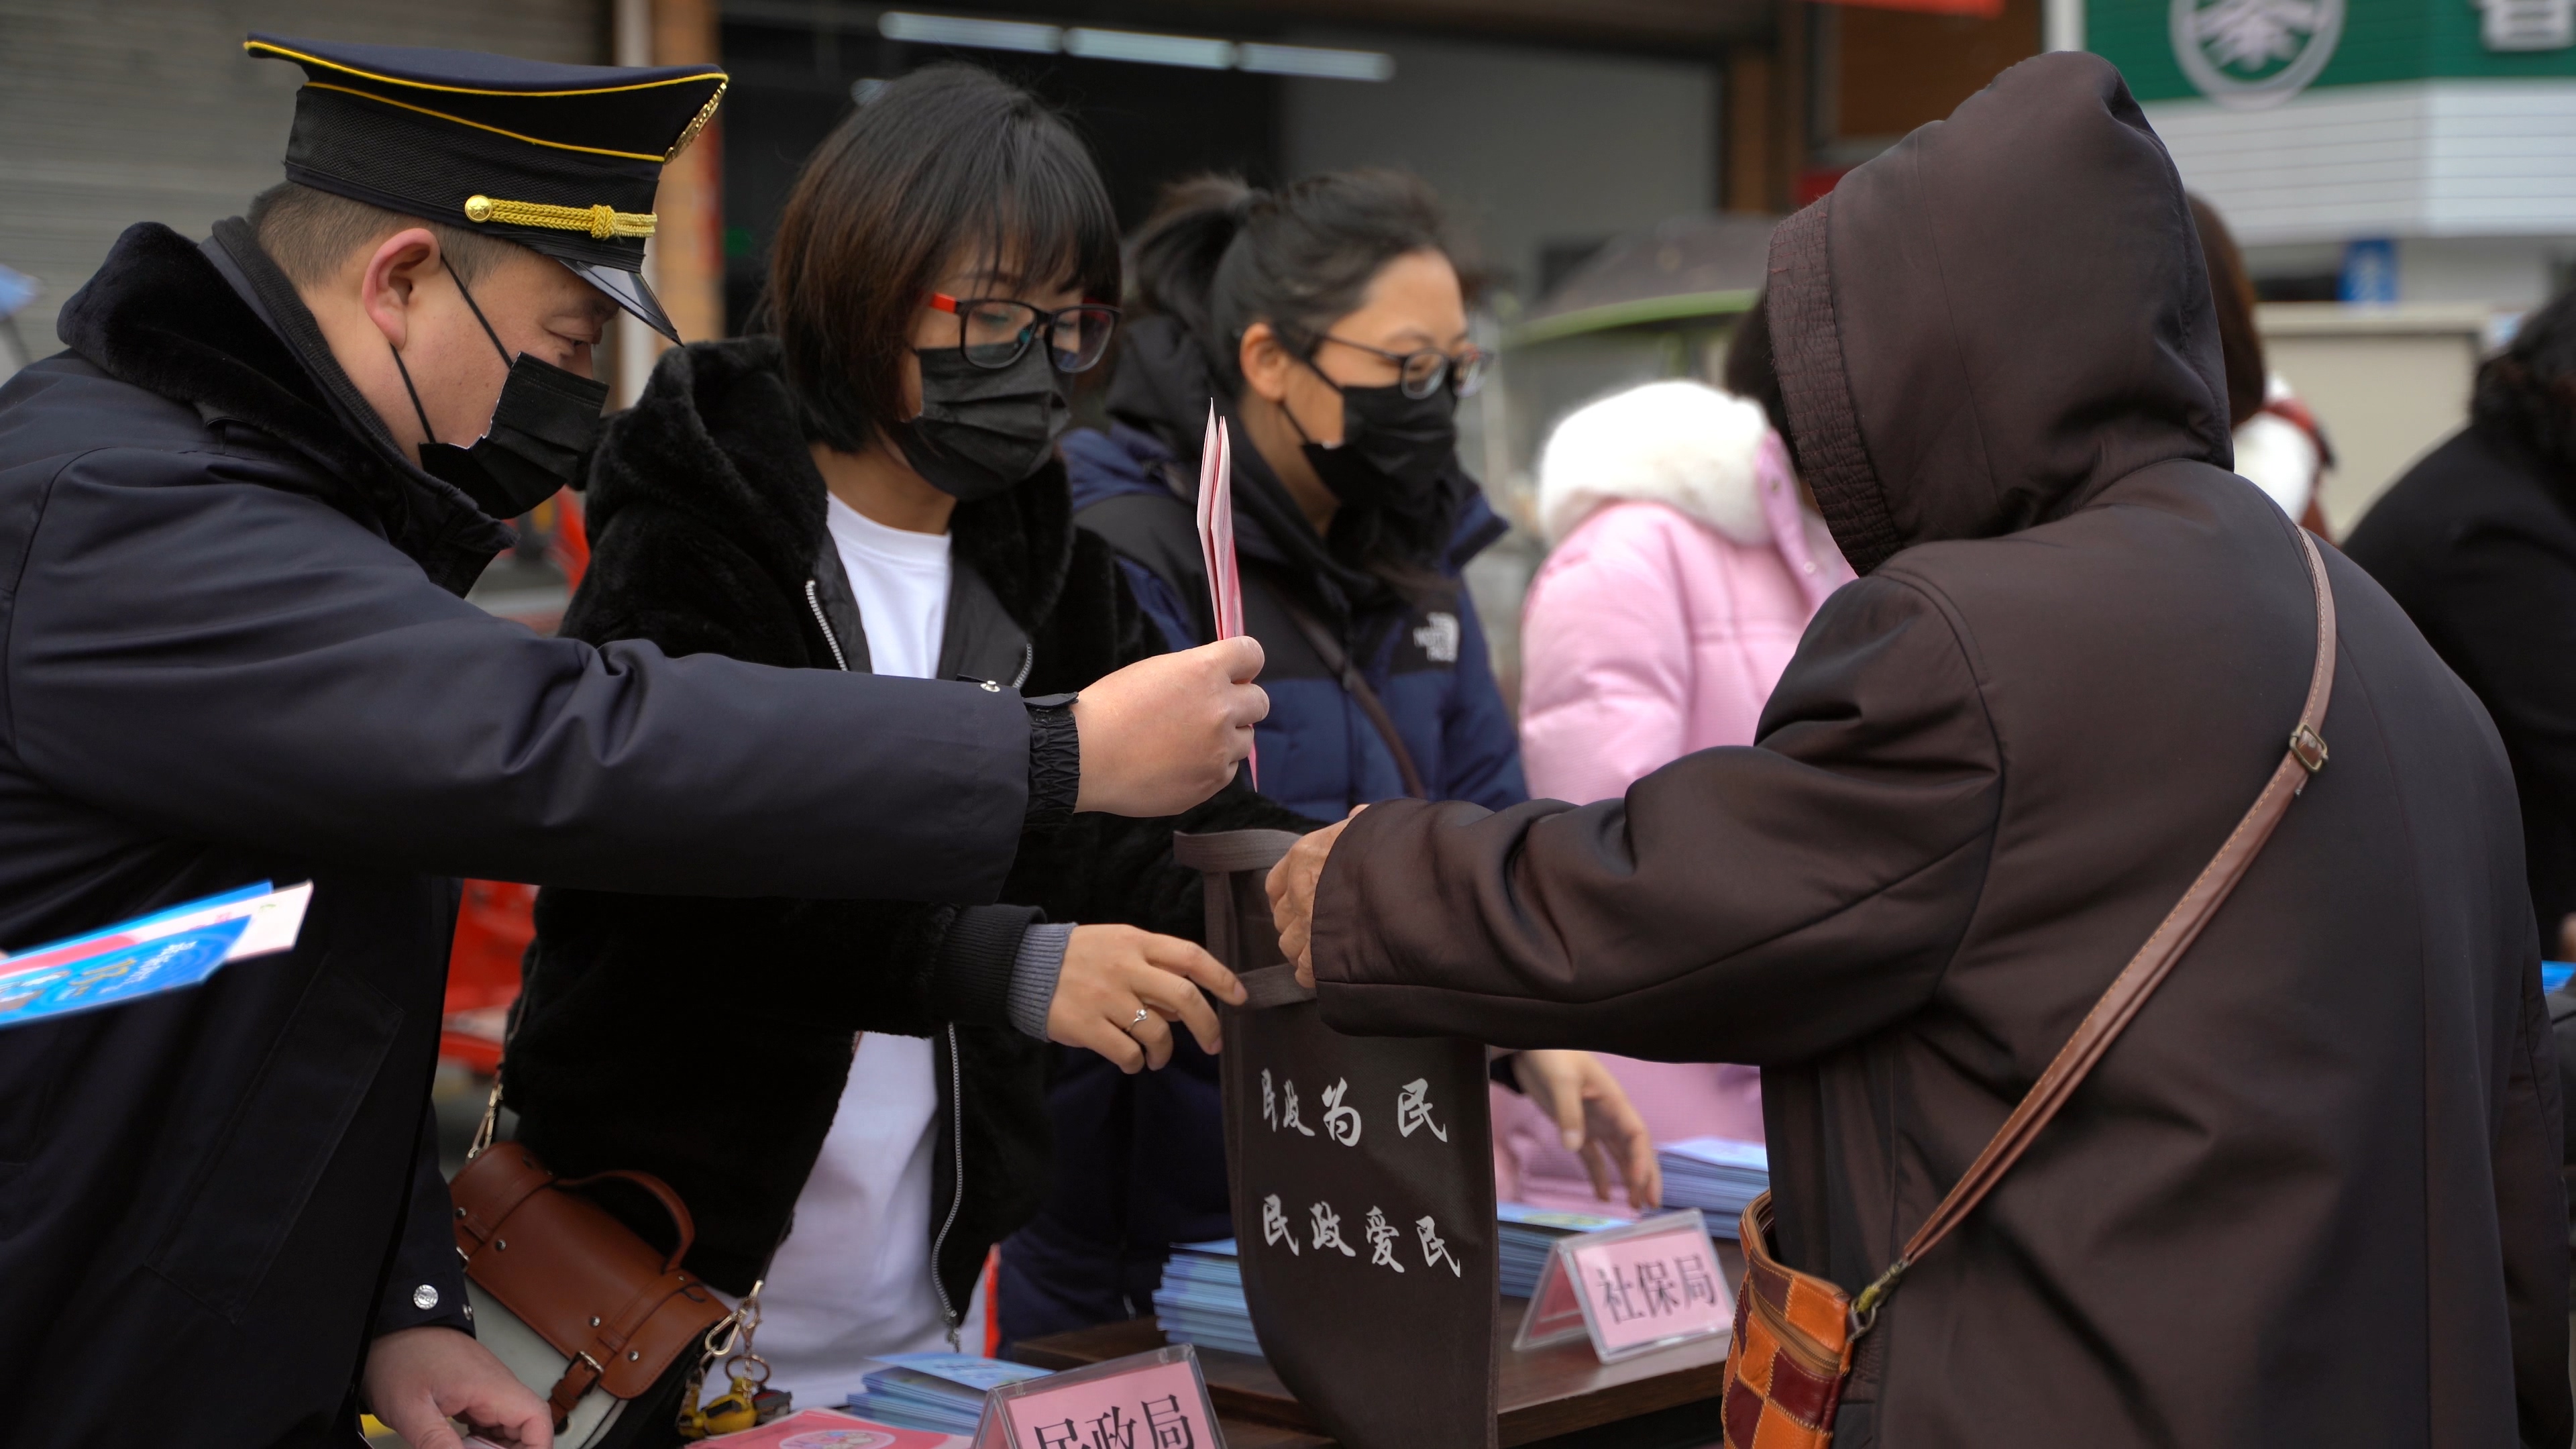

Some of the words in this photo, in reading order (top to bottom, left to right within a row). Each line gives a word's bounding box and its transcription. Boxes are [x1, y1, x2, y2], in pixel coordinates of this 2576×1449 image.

[1261, 1068, 1448, 1147] 民政为民
[1263, 1193, 1460, 1278] 民政爱民
[1596, 1254, 1717, 1324] 社保局
